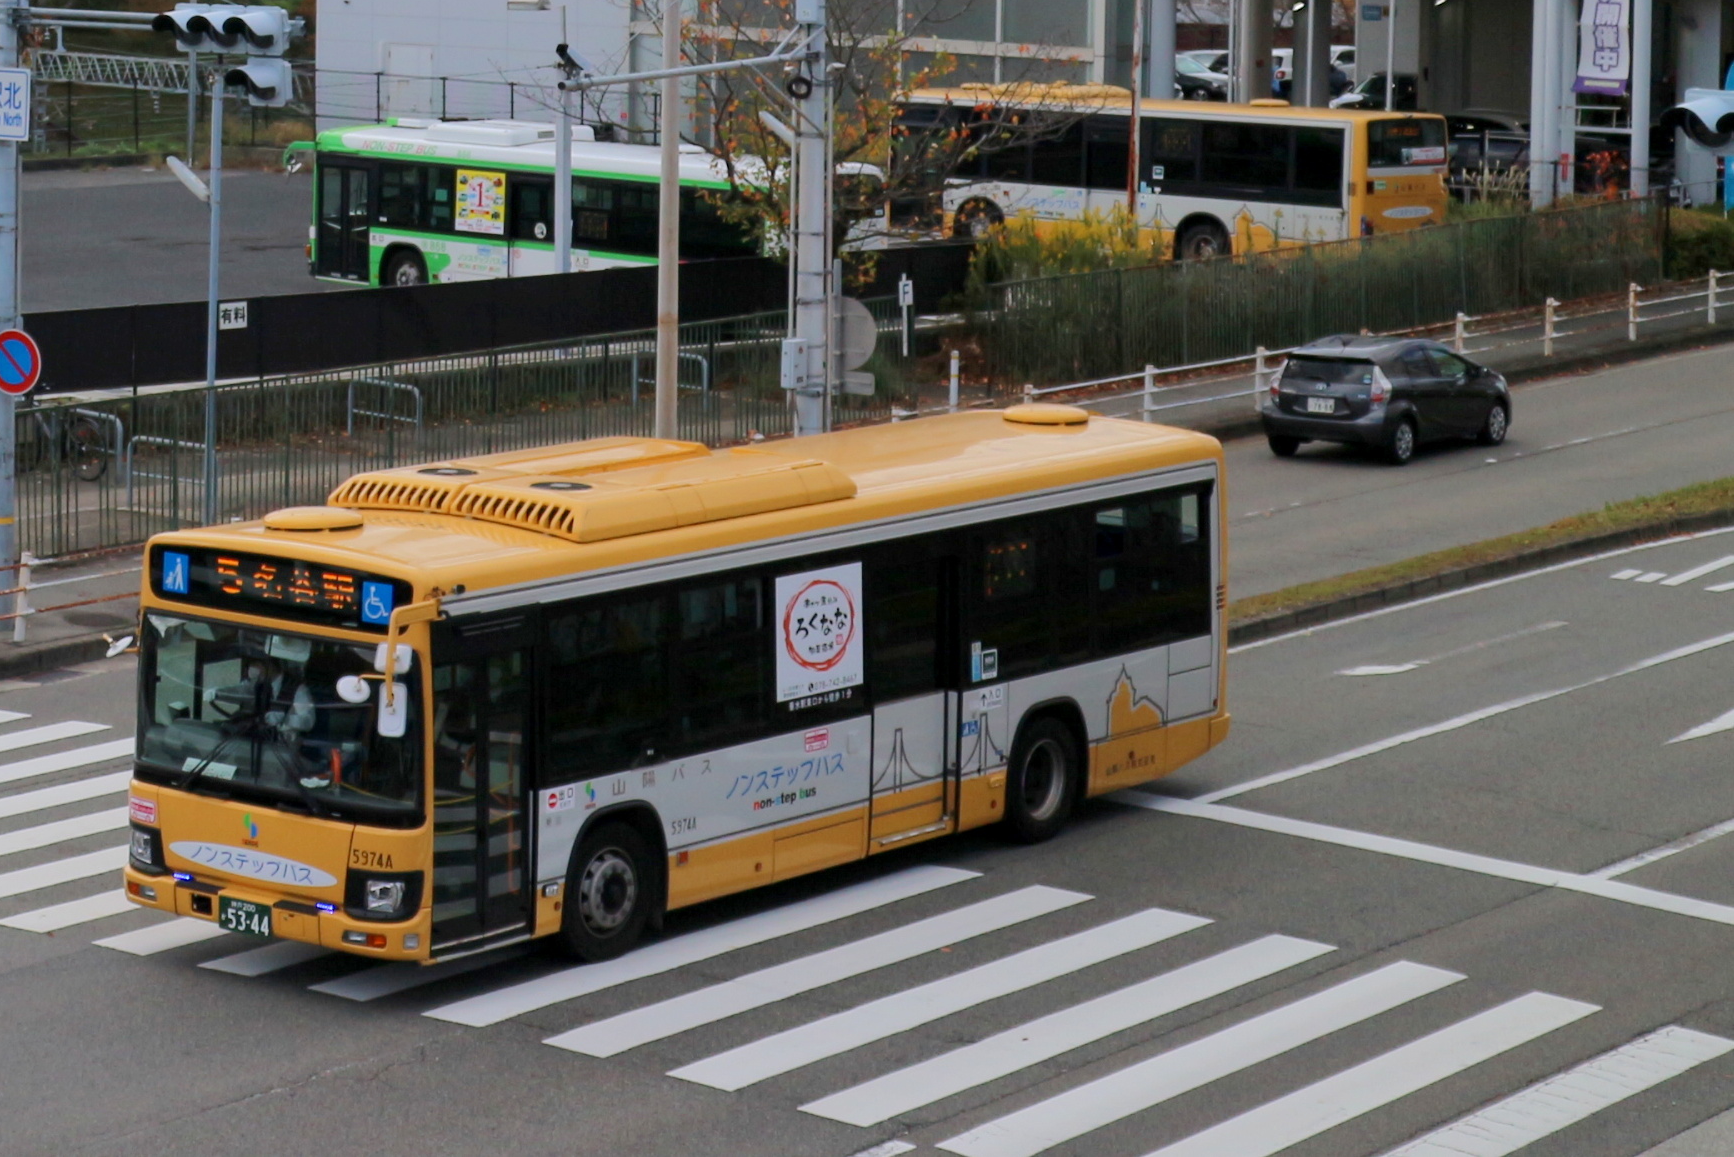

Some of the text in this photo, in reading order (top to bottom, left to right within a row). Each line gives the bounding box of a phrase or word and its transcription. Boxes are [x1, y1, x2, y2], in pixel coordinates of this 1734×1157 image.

[3, 112, 22, 127] North
[903, 283, 910, 303] F
[221, 306, 246, 325] 有料
[795, 606, 849, 640] ろくなな
[612, 759, 712, 796] 山陽バス
[726, 752, 844, 799] ノンステップバス
[753, 787, 817, 811] non-step bus
[671, 816, 697, 835] 5974A
[190, 845, 314, 885] ノンステップバス
[352, 848, 394, 870] 5974A
